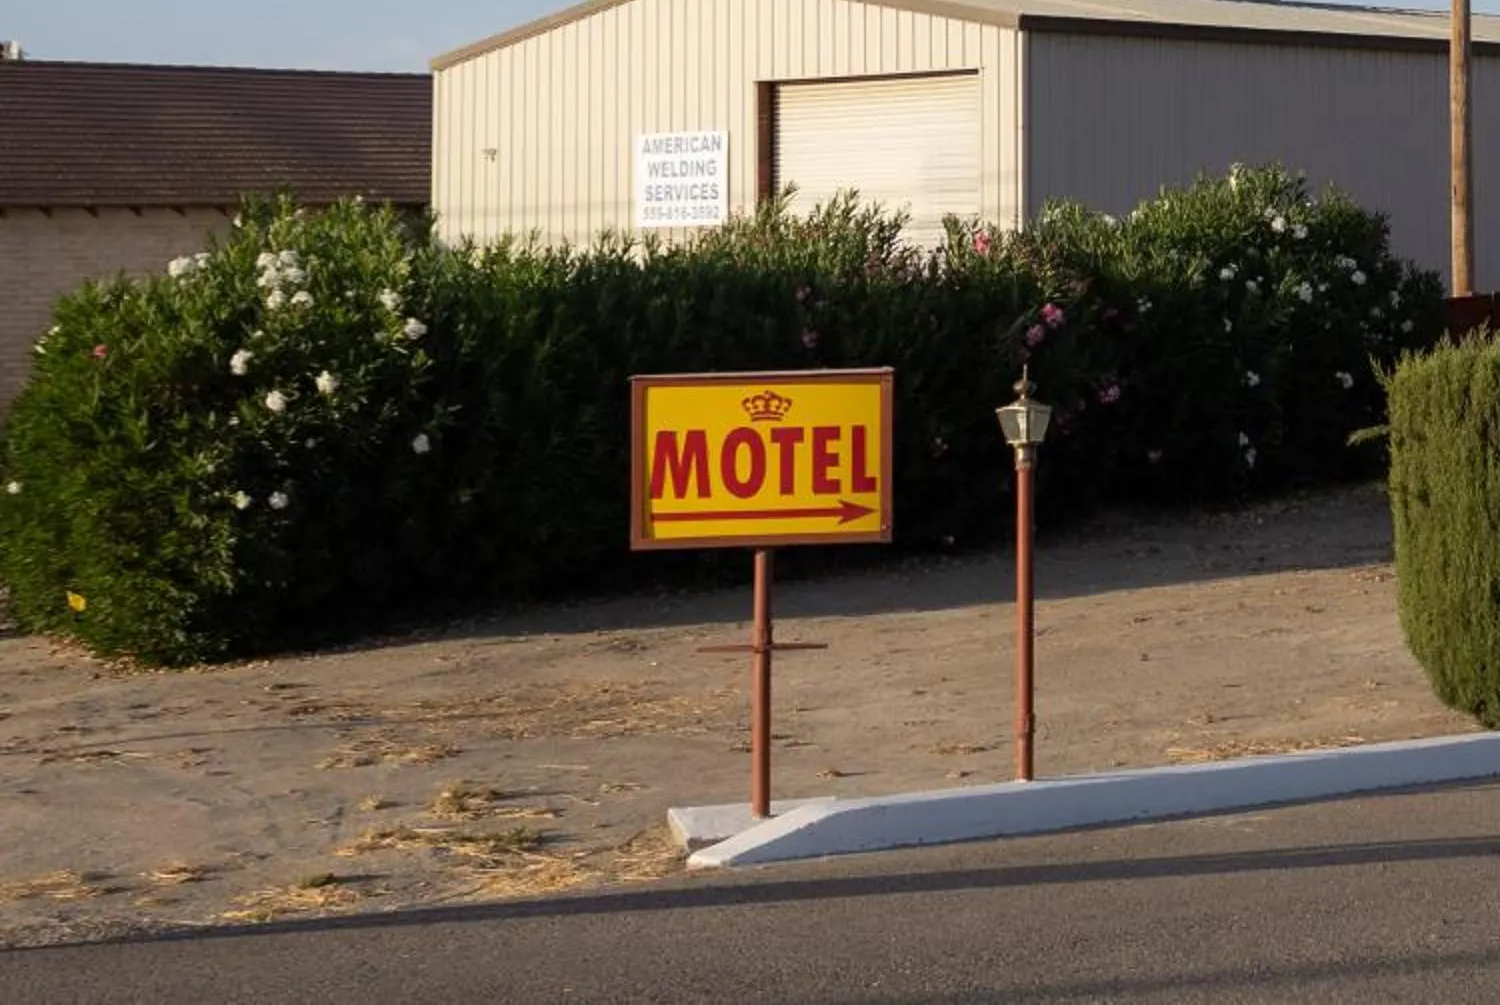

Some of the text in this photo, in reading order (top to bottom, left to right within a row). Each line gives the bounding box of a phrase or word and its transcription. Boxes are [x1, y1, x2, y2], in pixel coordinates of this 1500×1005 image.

[642, 135, 721, 154] AMERICAN
[647, 159, 717, 177] WELDING
[645, 182, 719, 201] SERVICES
[650, 425, 877, 499] MOTEL
